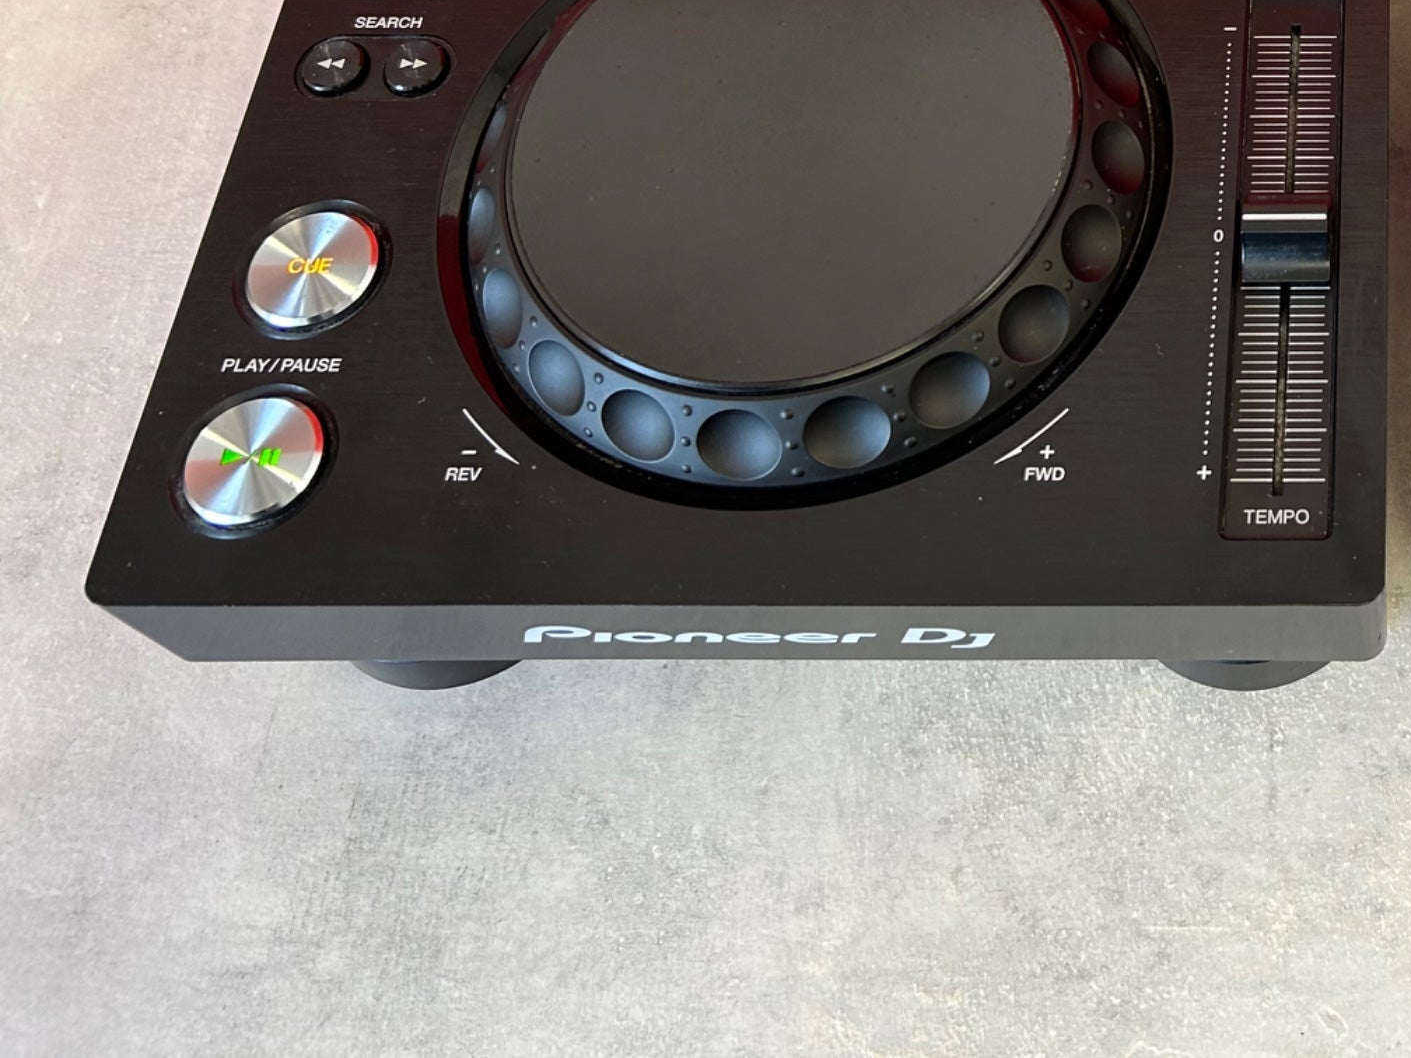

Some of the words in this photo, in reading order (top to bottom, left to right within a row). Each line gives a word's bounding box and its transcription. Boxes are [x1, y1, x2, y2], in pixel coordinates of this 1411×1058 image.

[354, 17, 423, 29] SEARCH
[1213, 229, 1224, 242] 0
[287, 257, 333, 275] CUE
[221, 358, 342, 373] PLAY/PAUSE
[445, 468, 482, 481] REV
[1024, 466, 1066, 481] FWD
[1244, 509, 1310, 525] TEMPO
[523, 624, 877, 644] Pioneer
